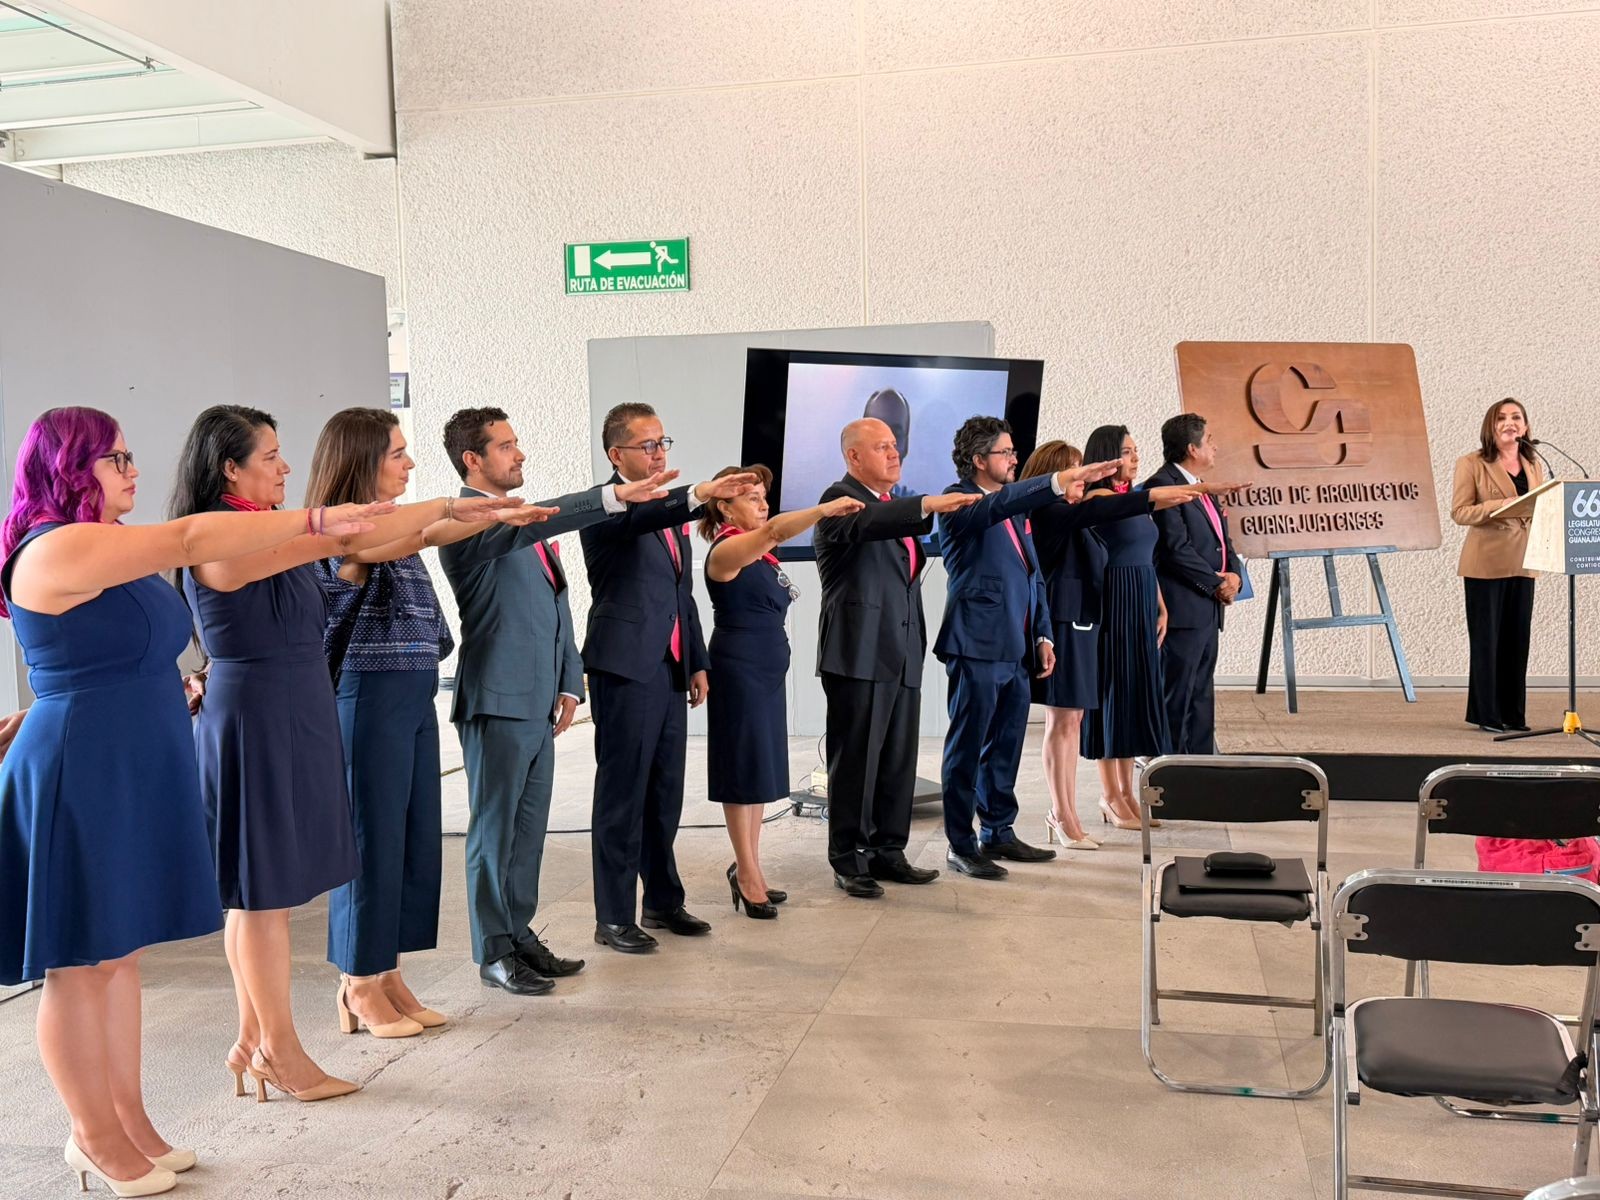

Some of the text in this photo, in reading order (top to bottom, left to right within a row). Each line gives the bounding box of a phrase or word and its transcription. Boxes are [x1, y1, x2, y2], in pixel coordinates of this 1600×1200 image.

[570, 271, 685, 291] RUTA DE EVACUACIÓN
[1317, 482, 1419, 503] ARQUITECTOS
[1241, 511, 1383, 535] GUANAJUATENSES
